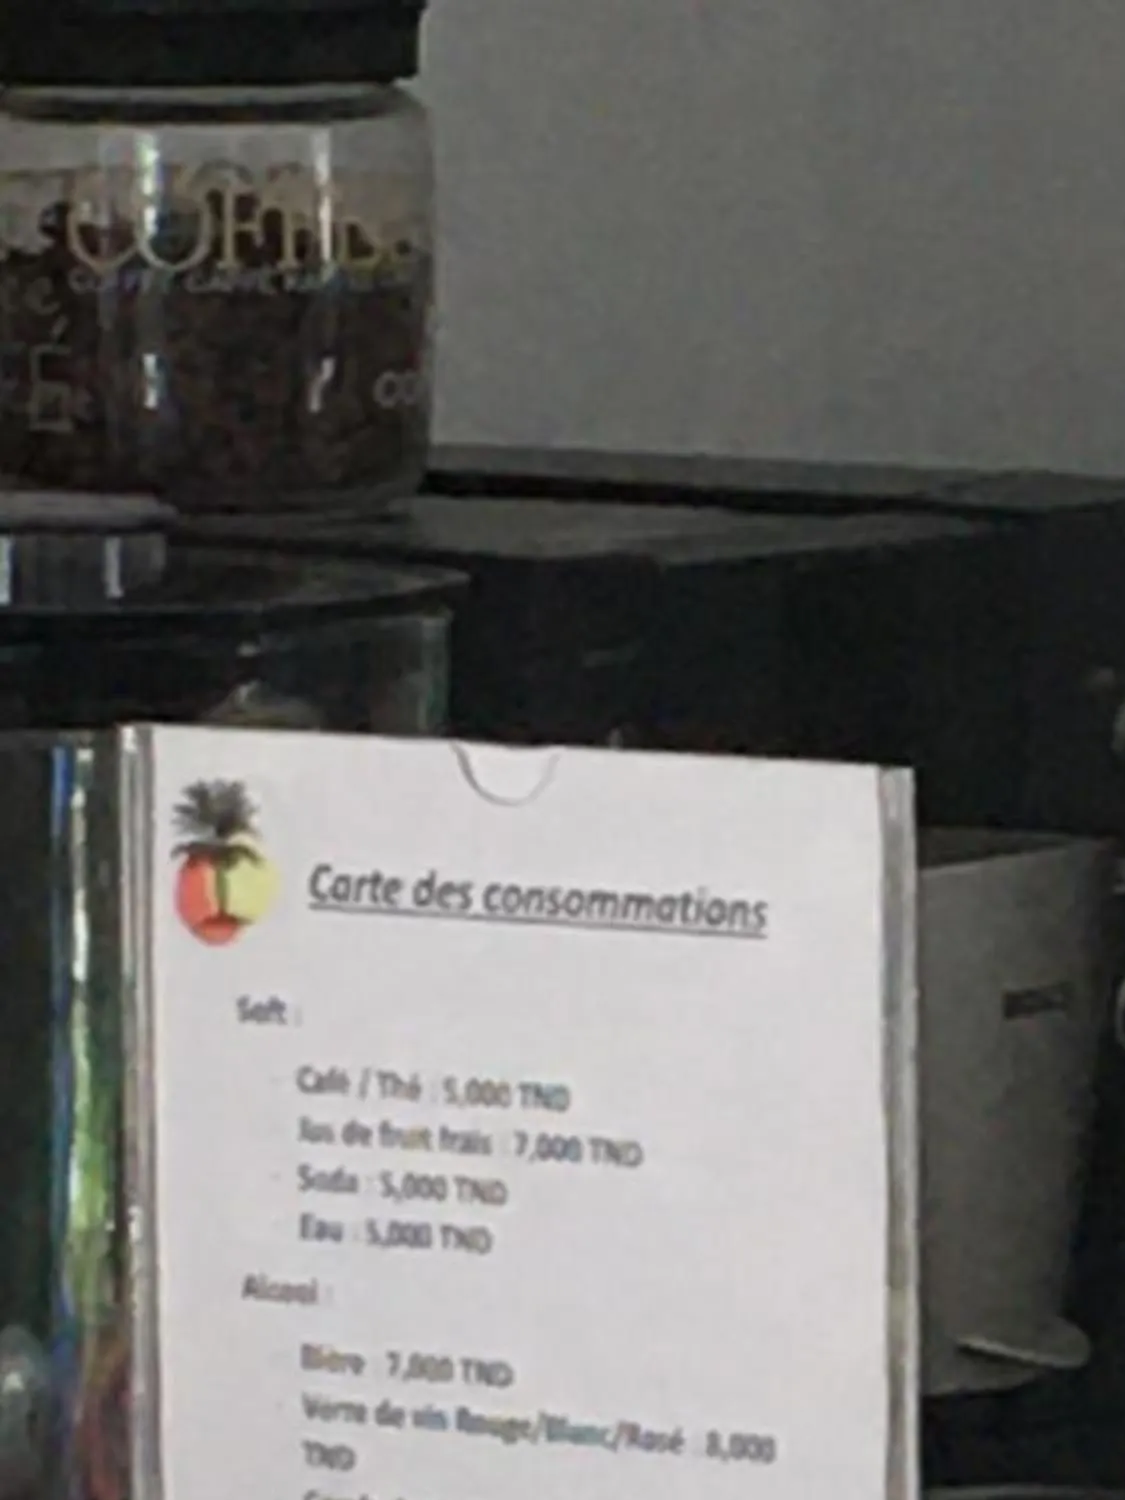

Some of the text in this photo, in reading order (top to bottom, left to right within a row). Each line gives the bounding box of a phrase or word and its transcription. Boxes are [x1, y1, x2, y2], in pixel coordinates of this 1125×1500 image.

[309, 863, 768, 930] Carte des consommations
